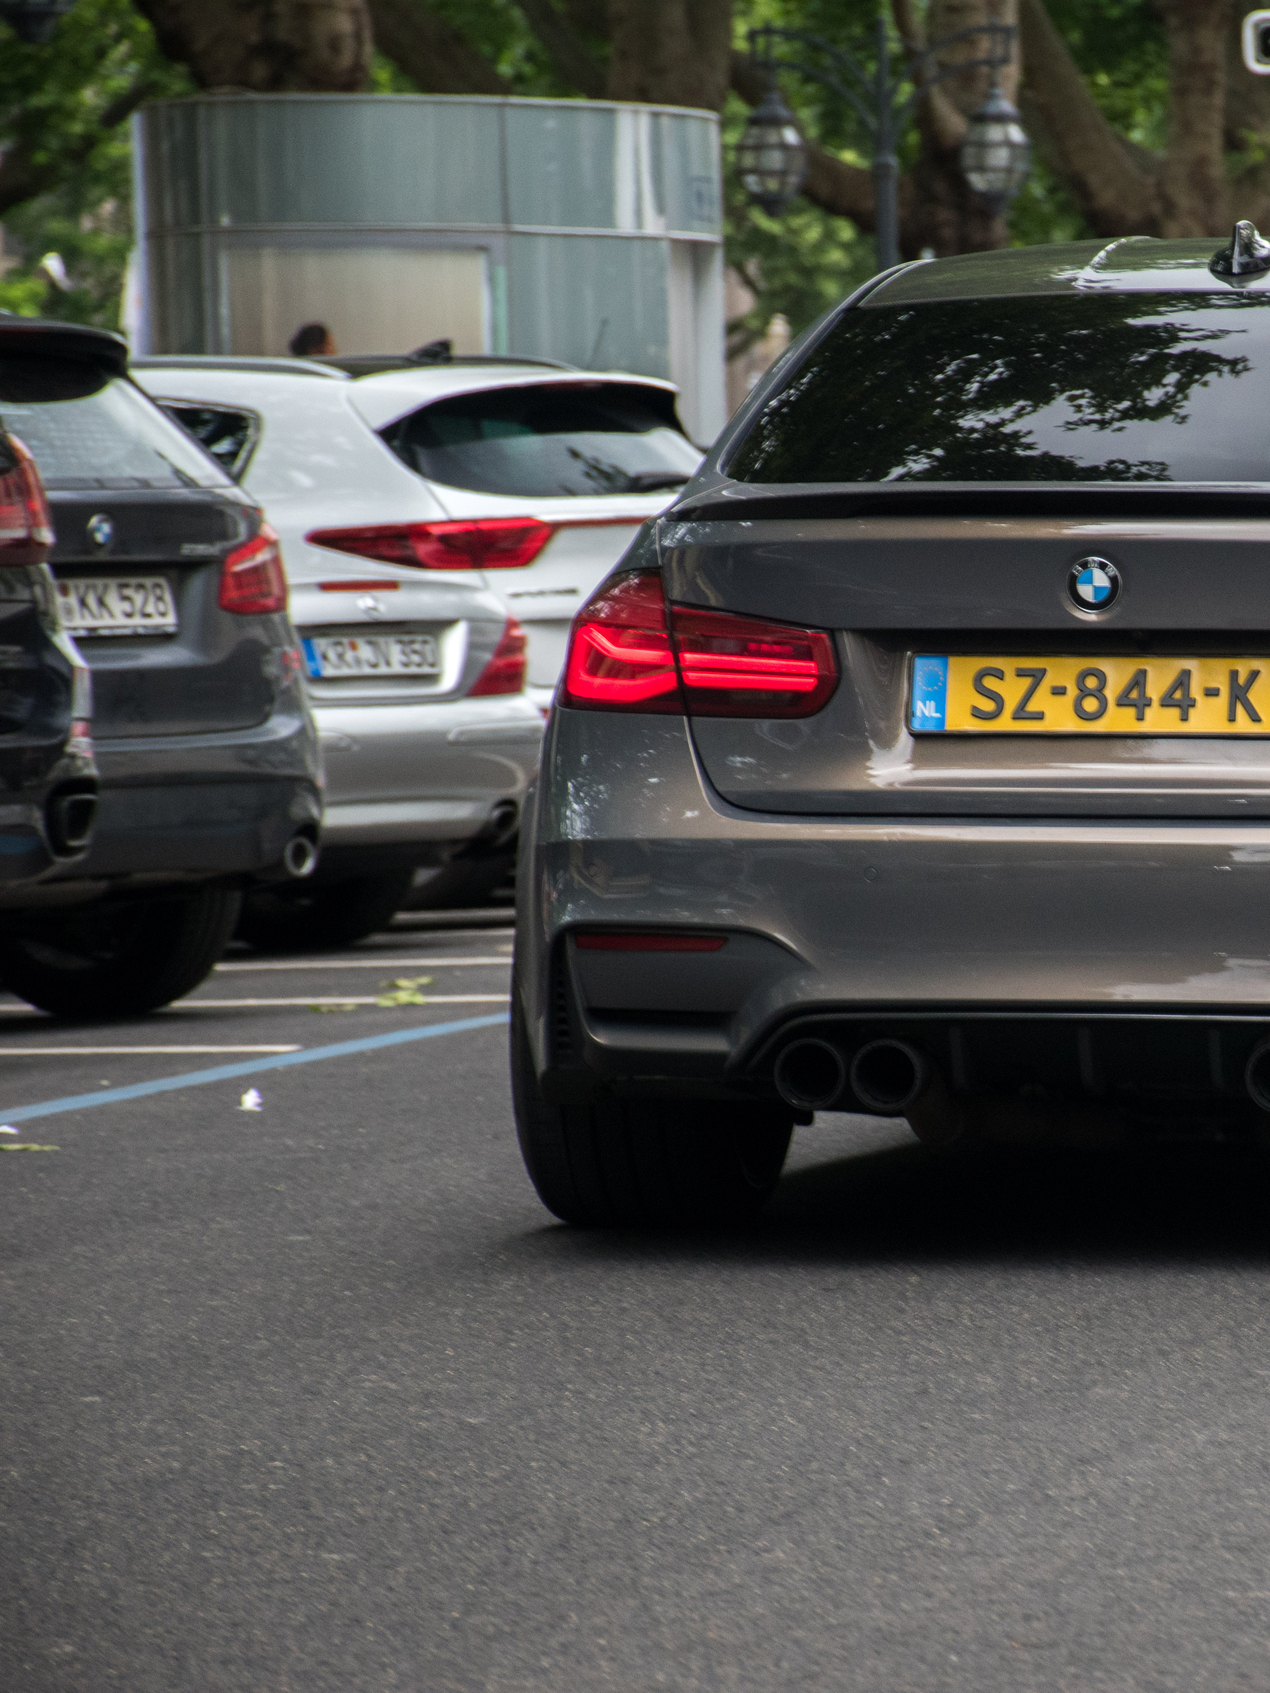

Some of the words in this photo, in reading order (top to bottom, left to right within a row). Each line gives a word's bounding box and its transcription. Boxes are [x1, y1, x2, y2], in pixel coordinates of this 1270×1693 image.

[1072, 558, 1117, 577] BMW
[118, 582, 168, 619] 528
[970, 666, 1263, 722] SZ-844-K
[916, 700, 942, 718] NL
